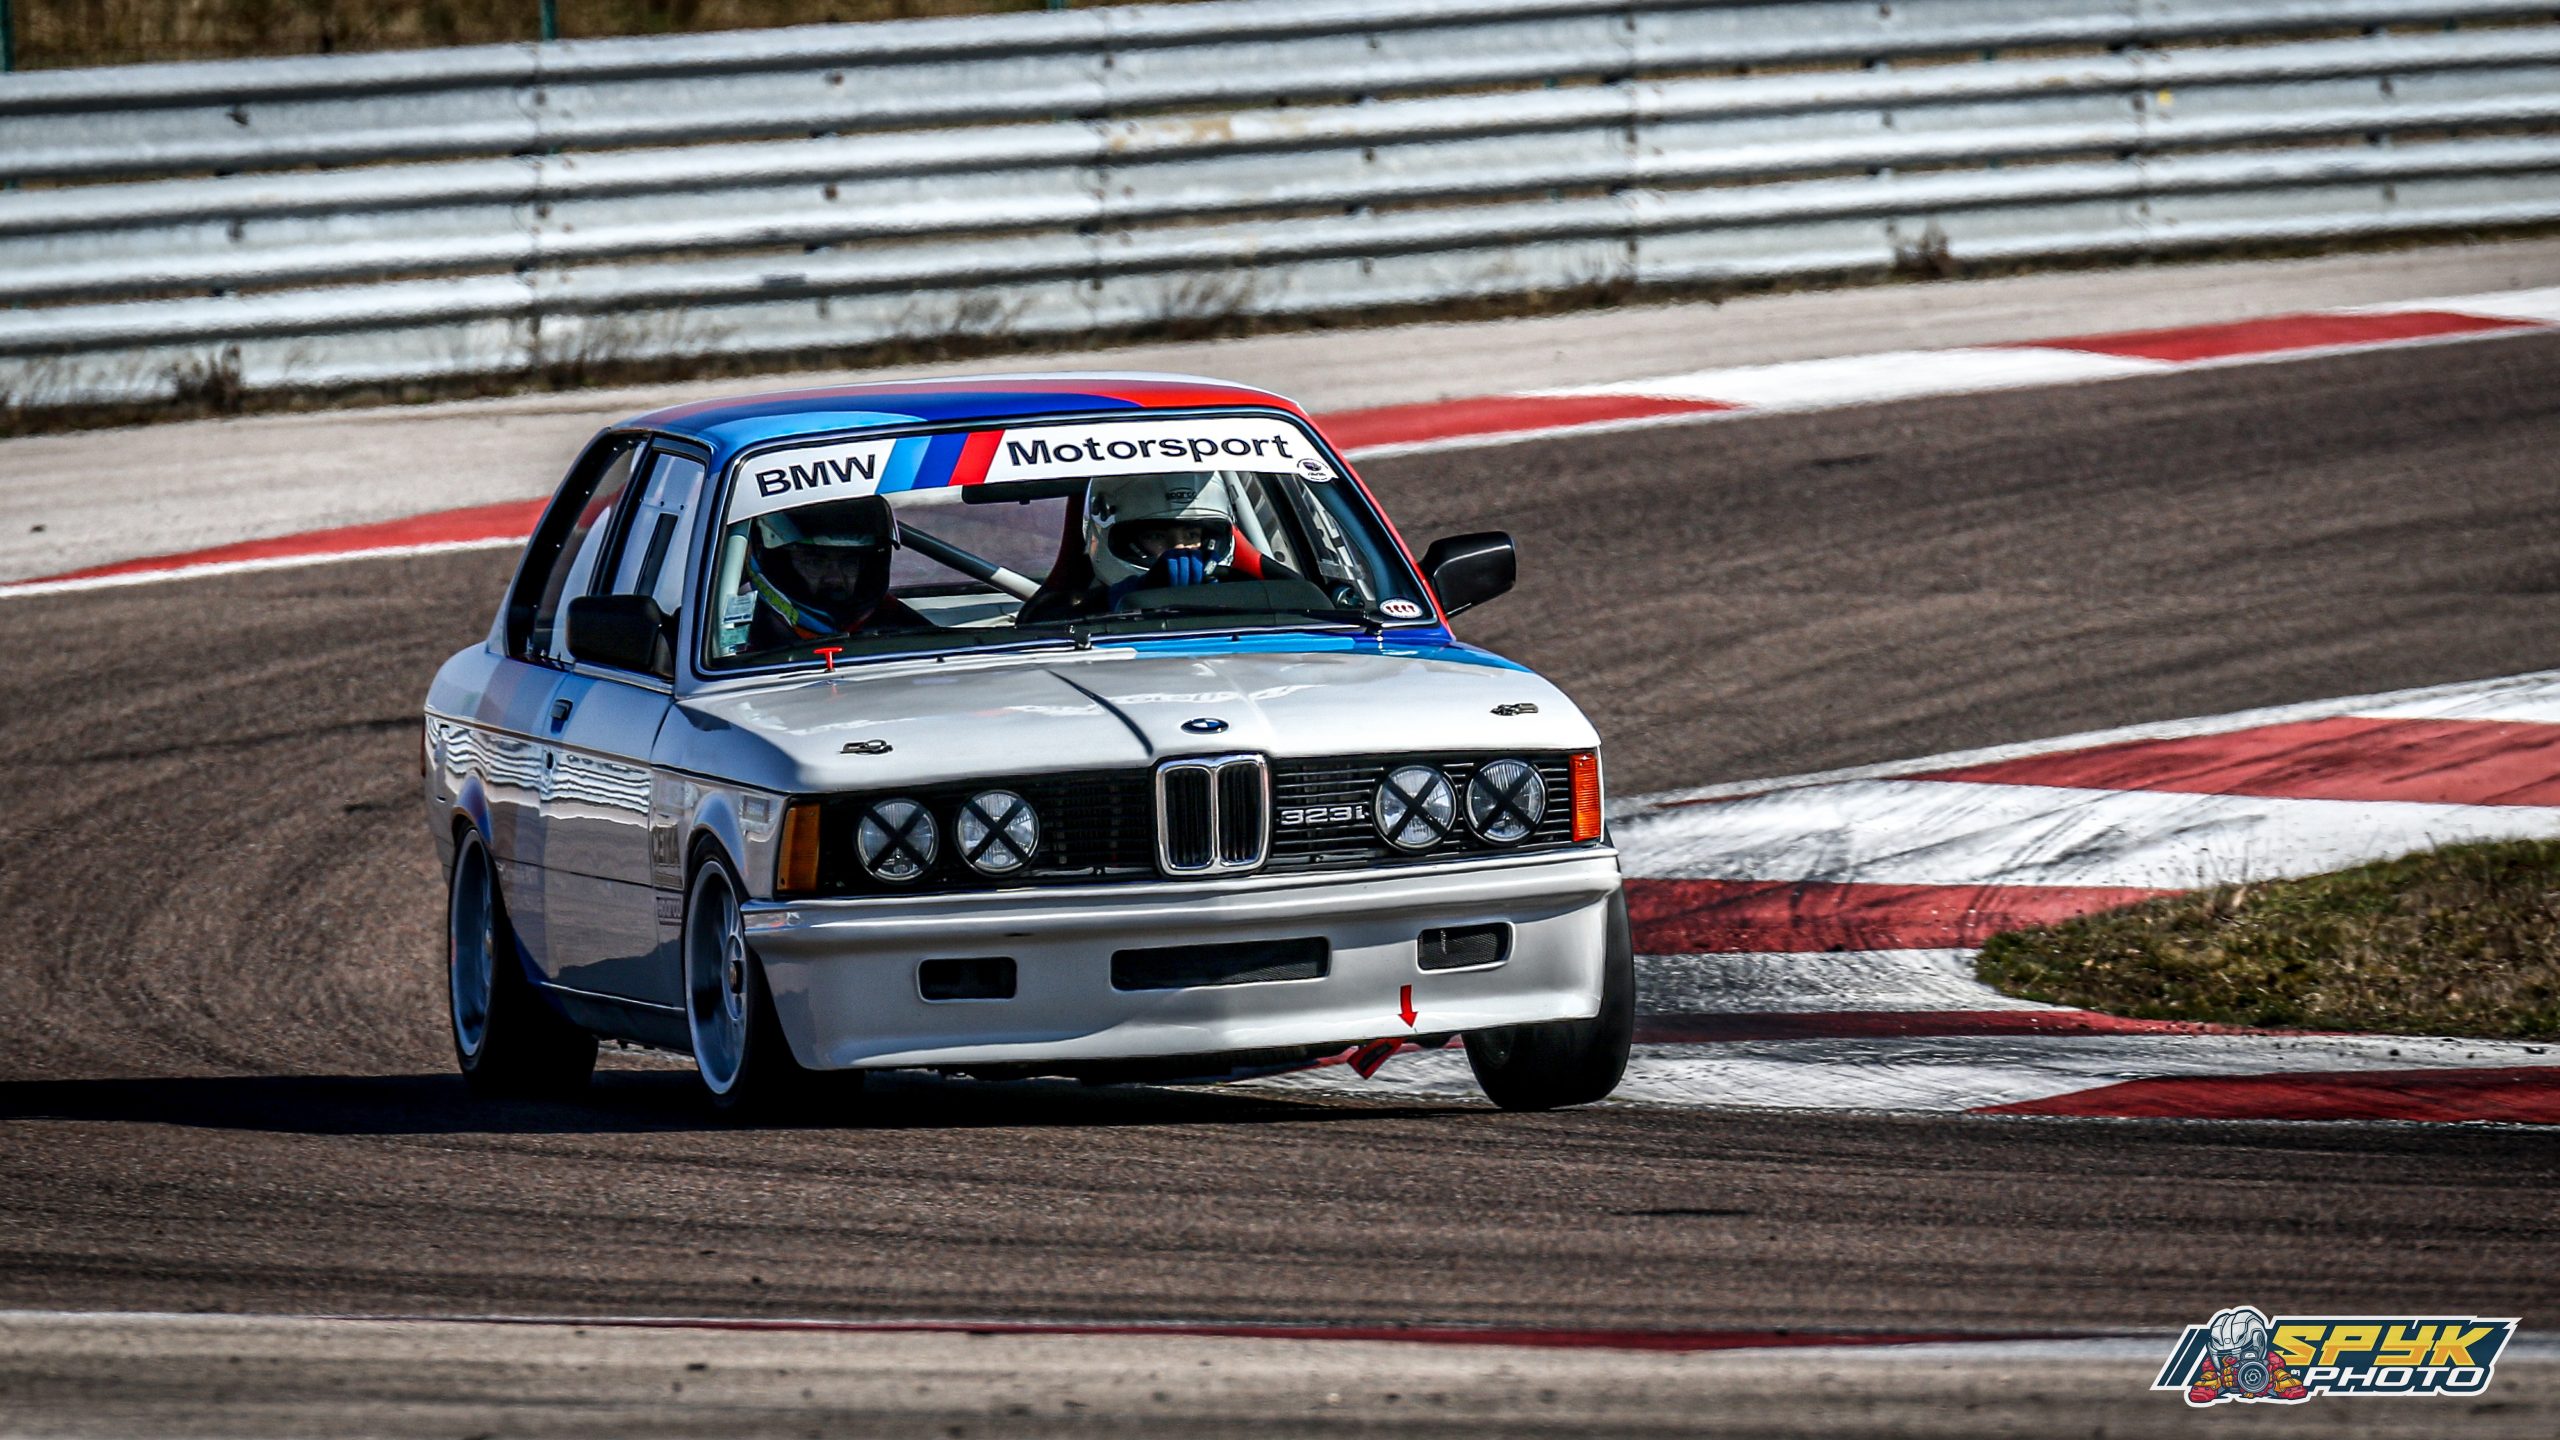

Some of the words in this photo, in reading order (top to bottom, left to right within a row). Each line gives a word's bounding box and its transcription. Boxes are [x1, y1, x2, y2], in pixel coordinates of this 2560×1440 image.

[755, 454, 876, 497] BMW
[1006, 435, 1293, 466] Motorsport
[1281, 806, 1366, 825] 323i
